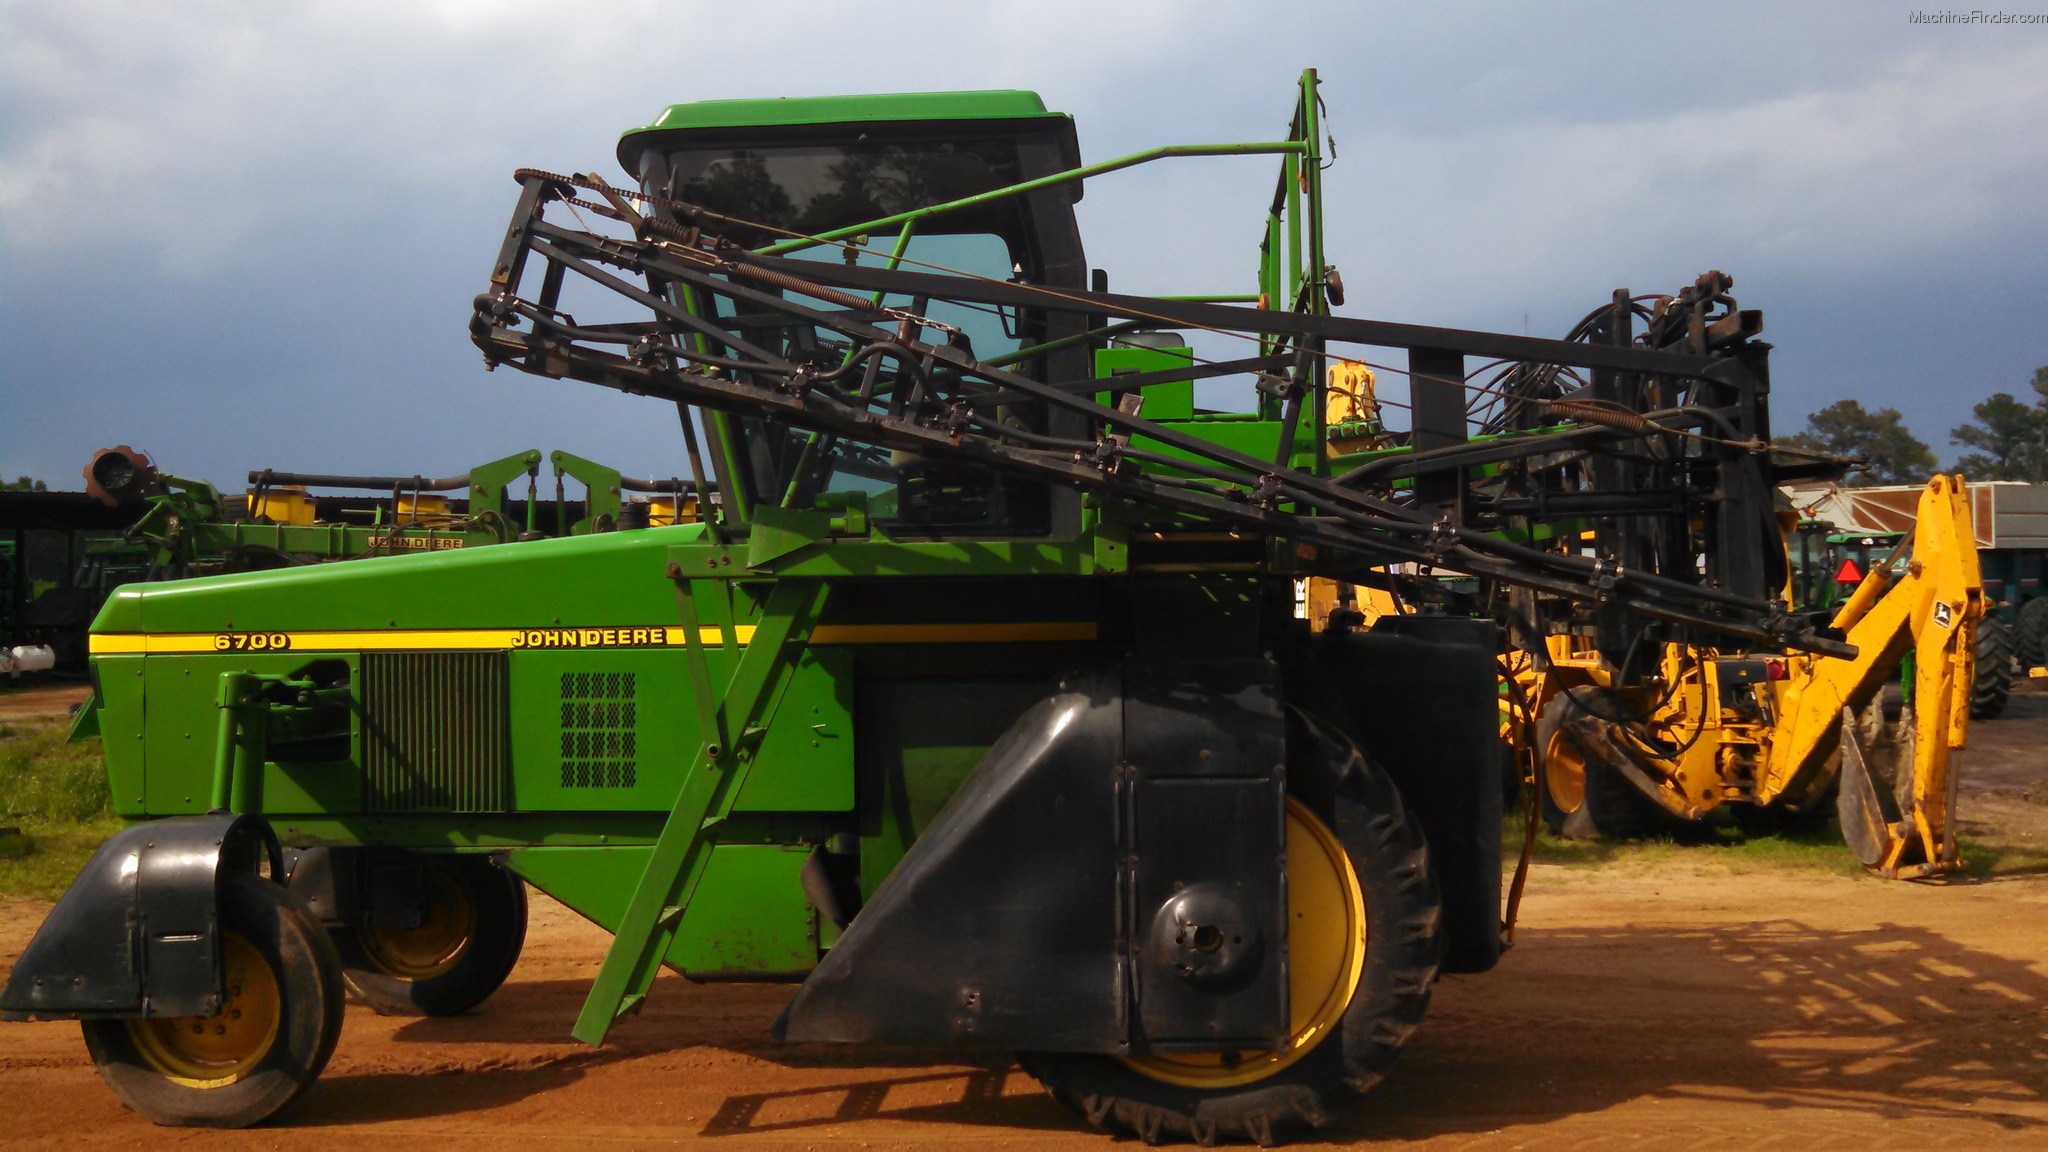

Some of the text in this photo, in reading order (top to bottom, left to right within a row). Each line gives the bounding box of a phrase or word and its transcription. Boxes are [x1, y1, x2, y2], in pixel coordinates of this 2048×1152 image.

[214, 633, 288, 650] 6700
[511, 628, 665, 648] JOHN DEERE
